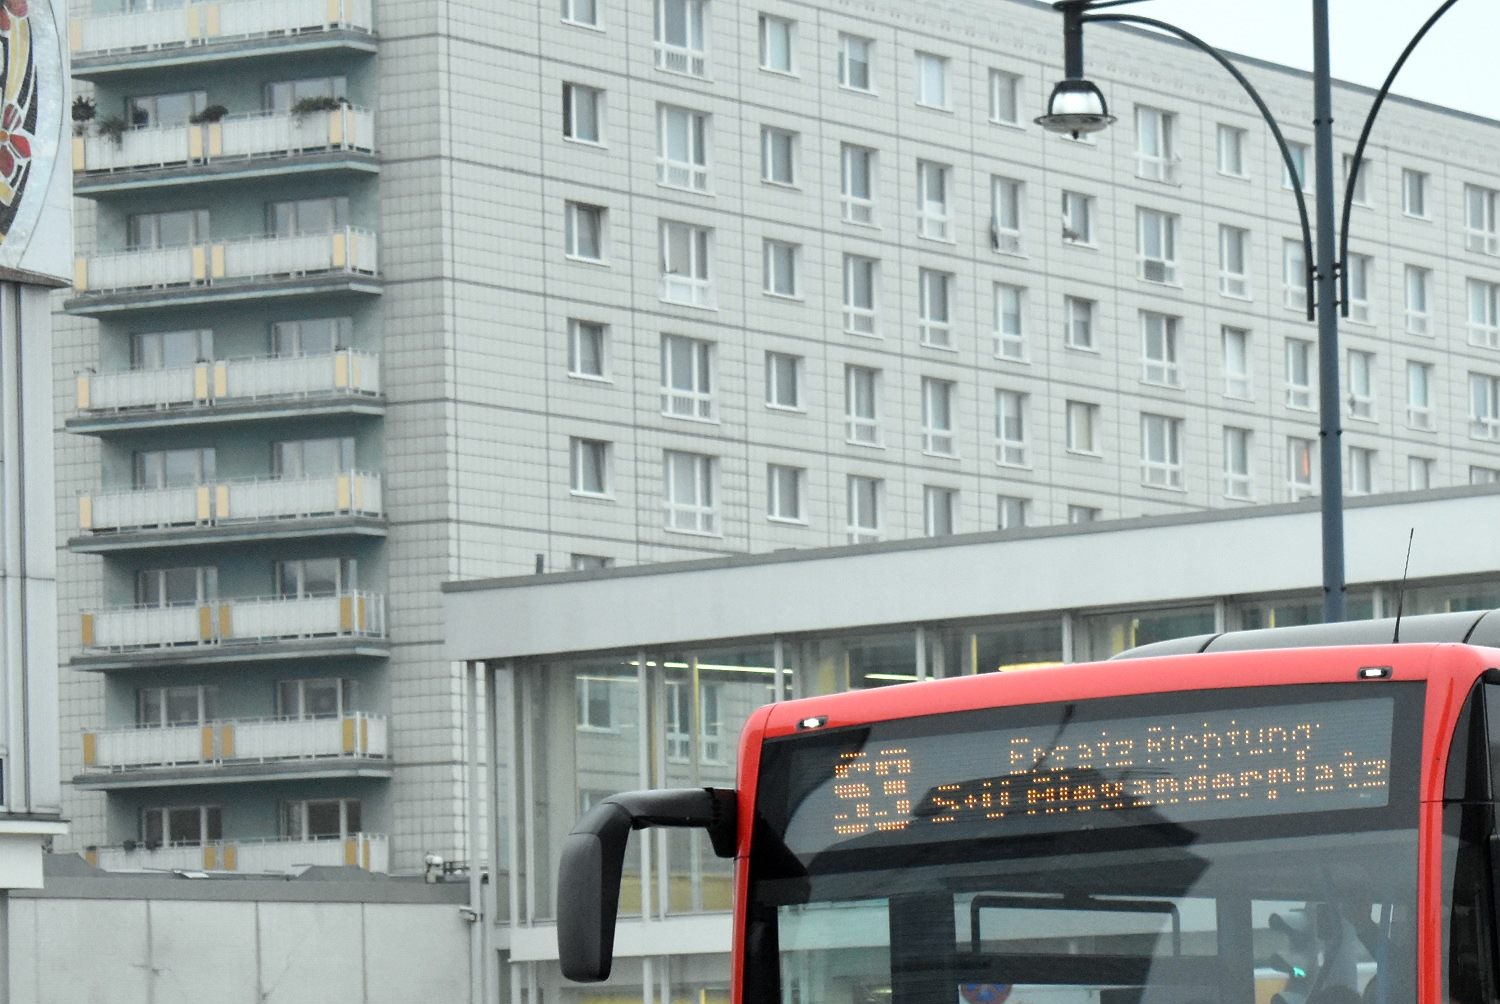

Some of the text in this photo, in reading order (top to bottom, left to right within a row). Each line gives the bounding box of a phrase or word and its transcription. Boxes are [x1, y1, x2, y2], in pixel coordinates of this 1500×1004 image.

[1009, 719, 1321, 775] Ersatz Richtung
[1026, 750, 1387, 815] Alexanderplatz
